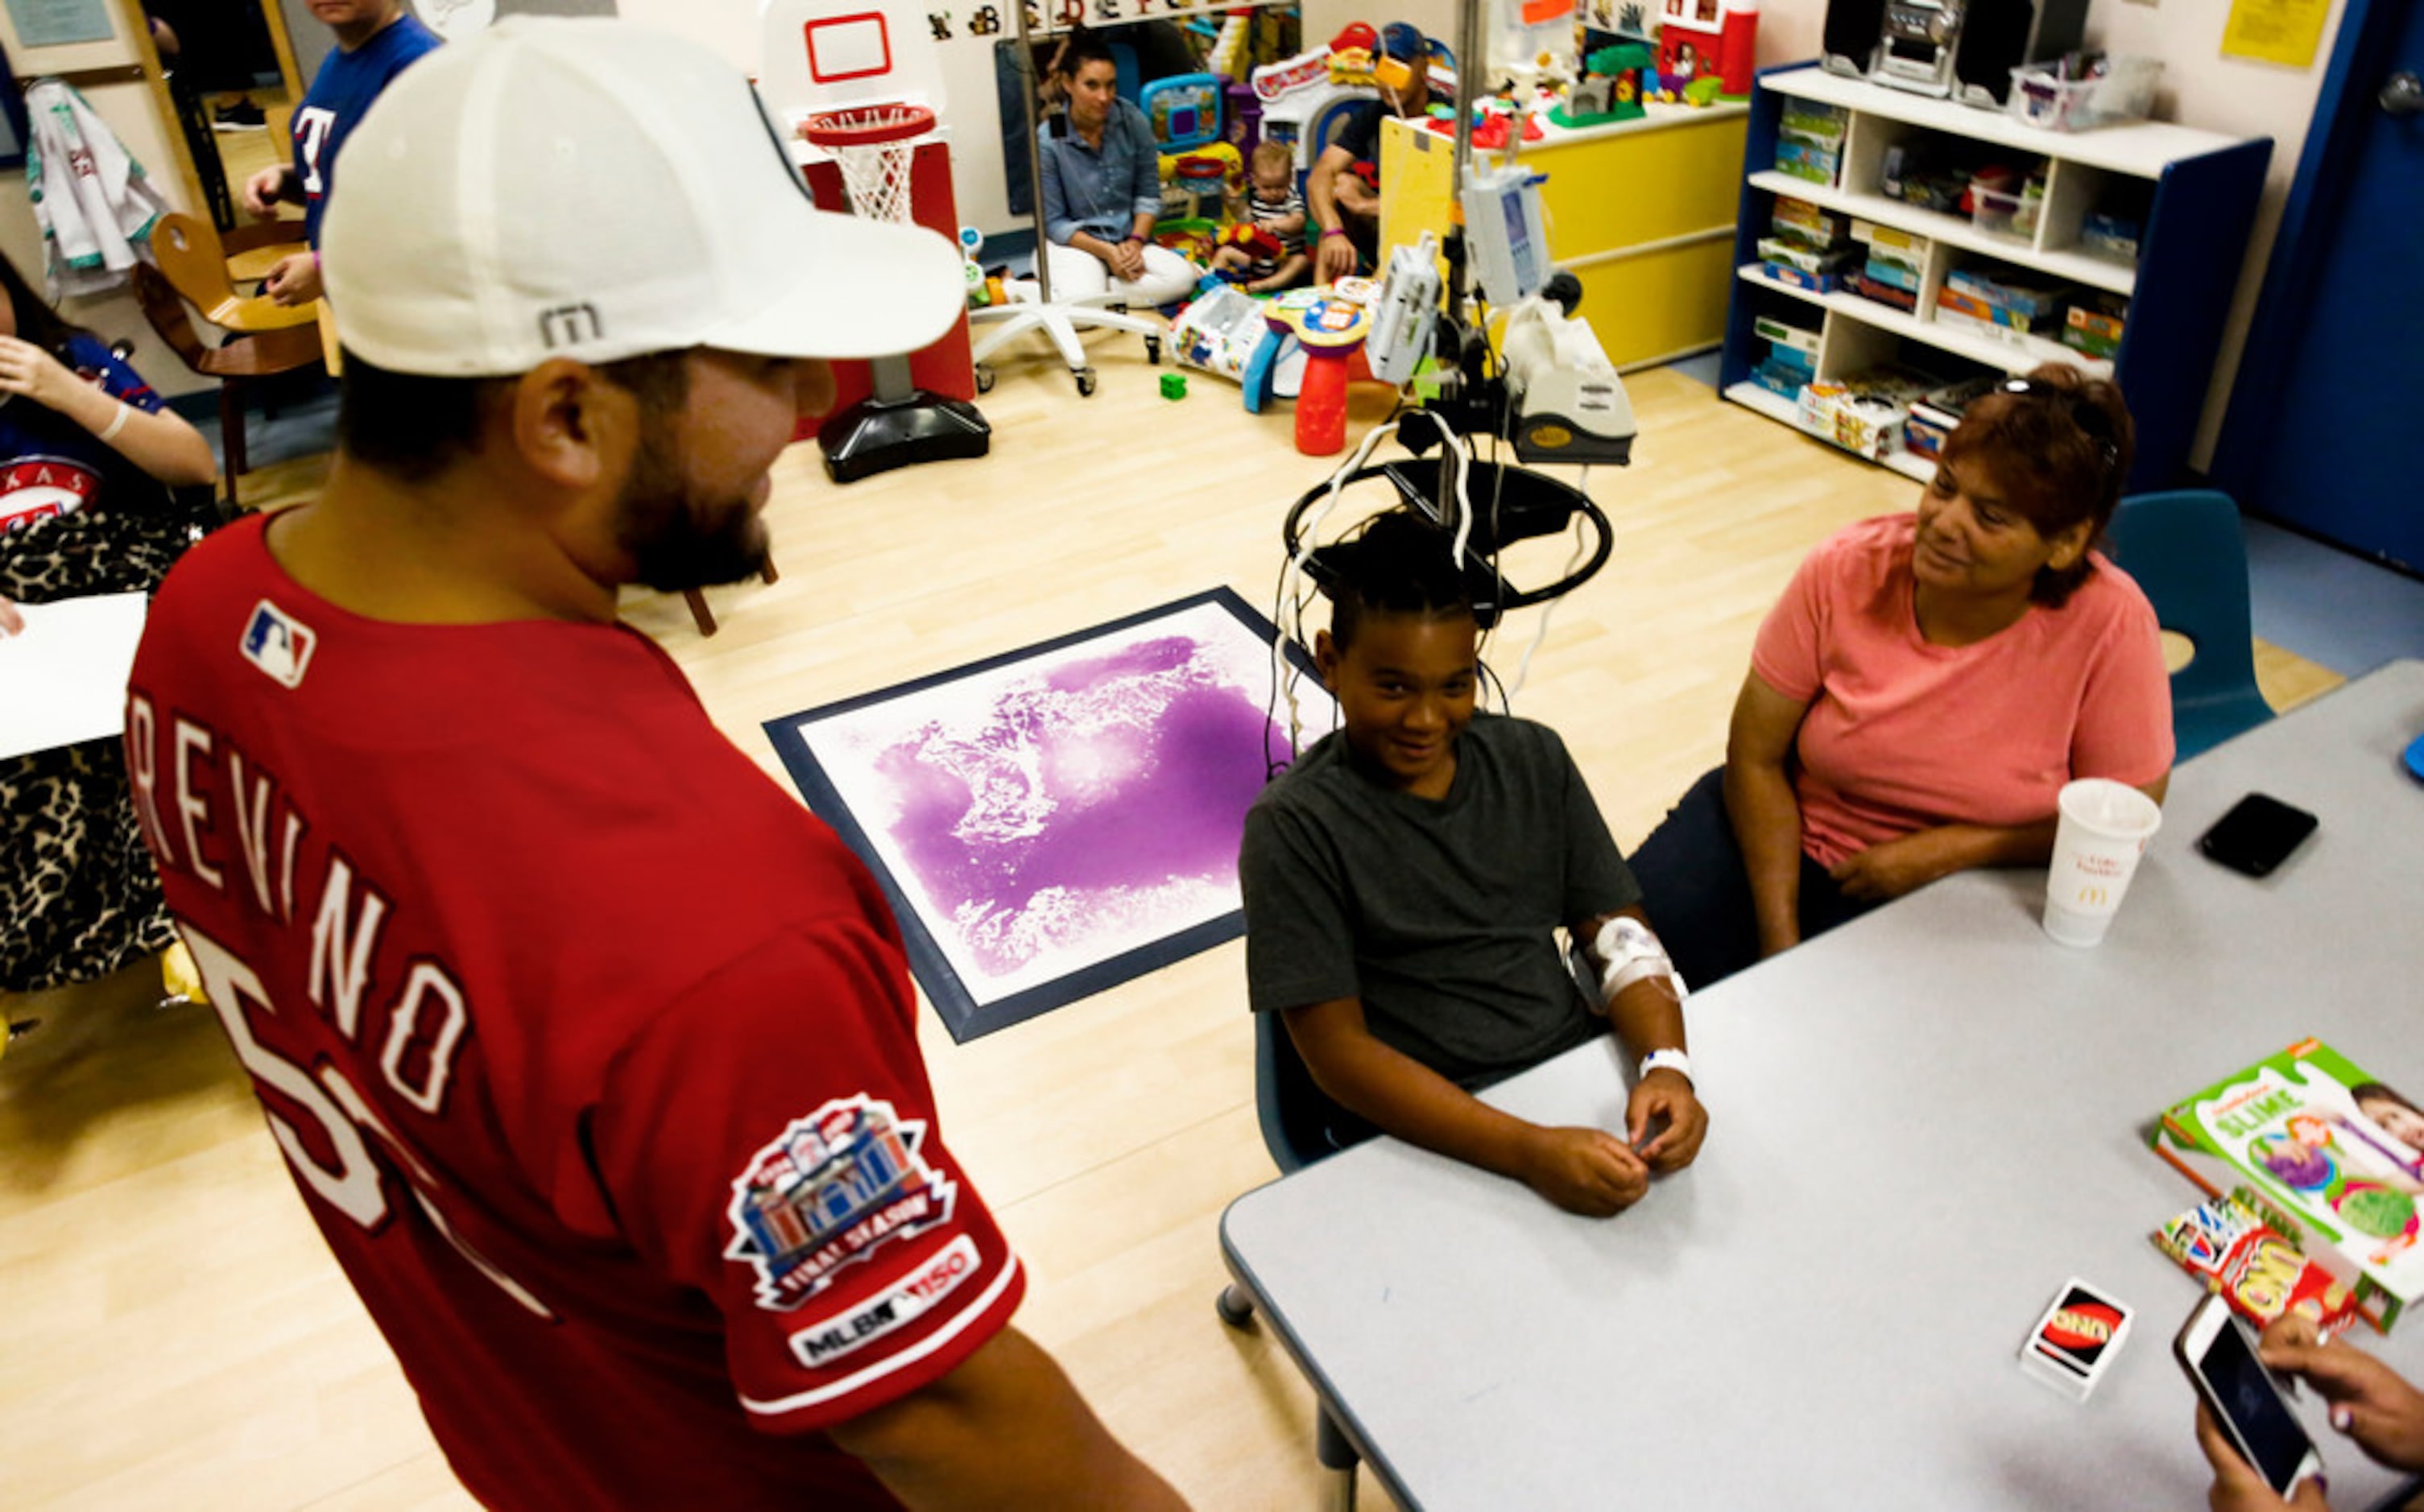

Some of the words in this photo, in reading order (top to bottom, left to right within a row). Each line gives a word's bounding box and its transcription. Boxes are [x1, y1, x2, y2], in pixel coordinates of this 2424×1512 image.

[295, 106, 337, 199] T
[2216, 1089, 2304, 1139] SLIME
[2236, 1239, 2308, 1316] UNO
[803, 1312, 877, 1359] MLB
[2051, 1308, 2111, 1345] UNO
